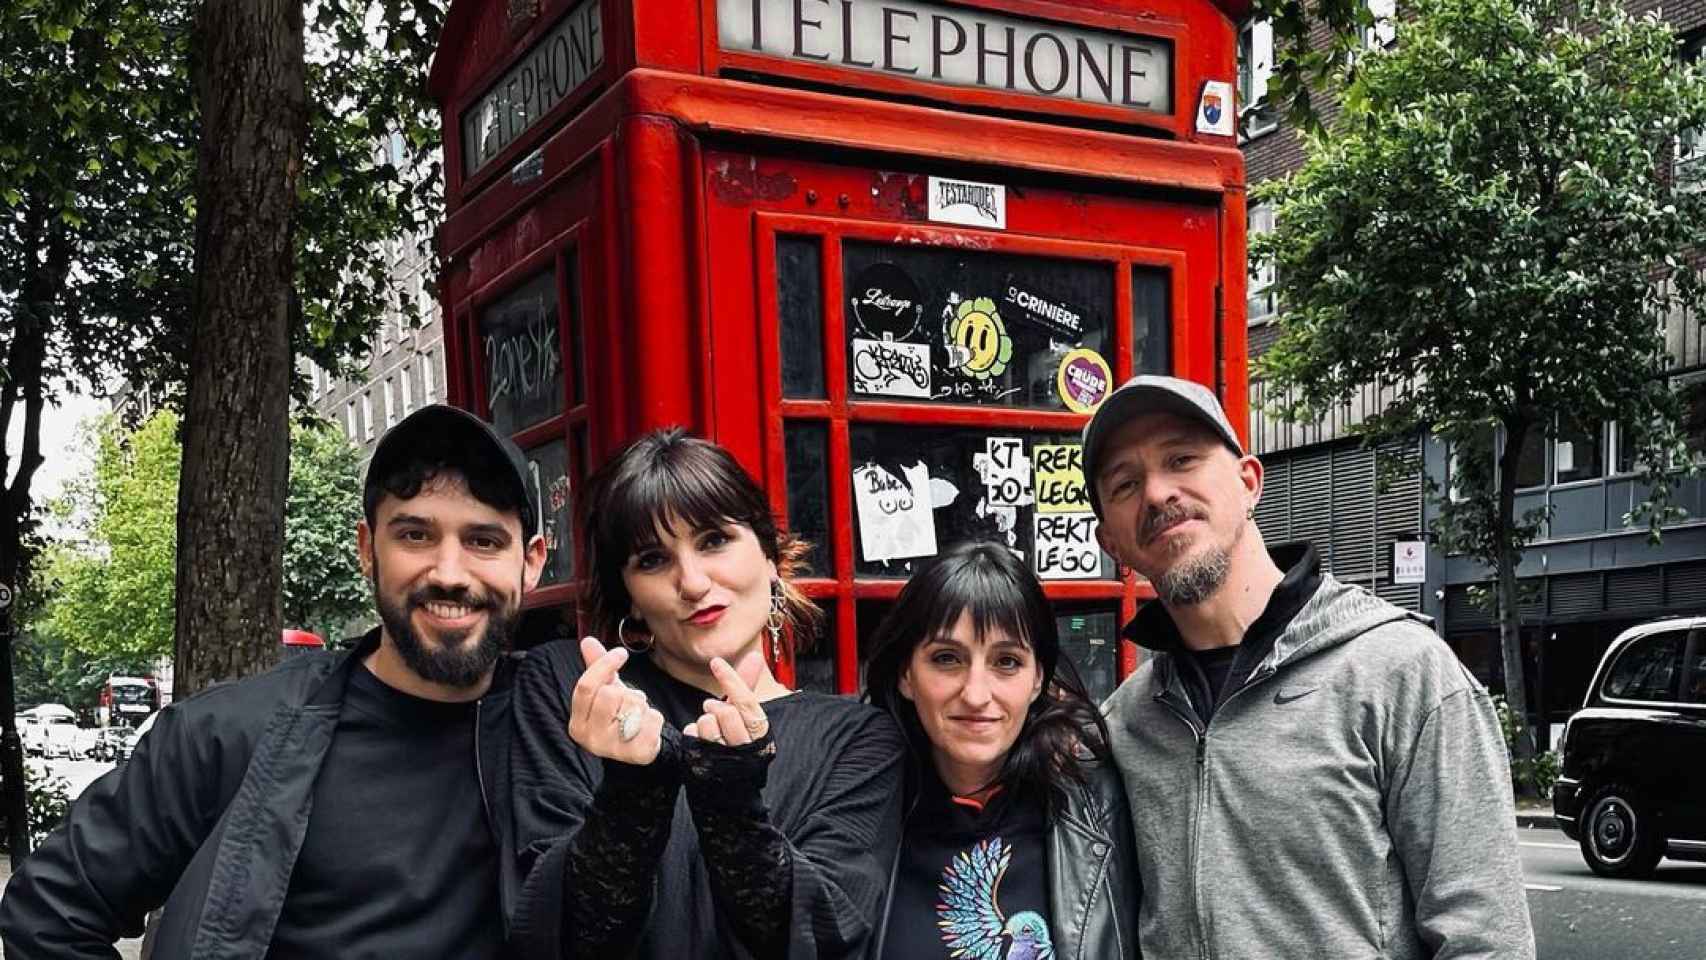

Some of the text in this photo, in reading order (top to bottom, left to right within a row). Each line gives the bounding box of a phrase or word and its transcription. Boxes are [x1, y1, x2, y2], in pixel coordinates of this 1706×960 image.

[751, 0, 1152, 107] TELEPHONE
[1037, 516, 1096, 543] REKT
[1038, 546, 1096, 573] LEGO
